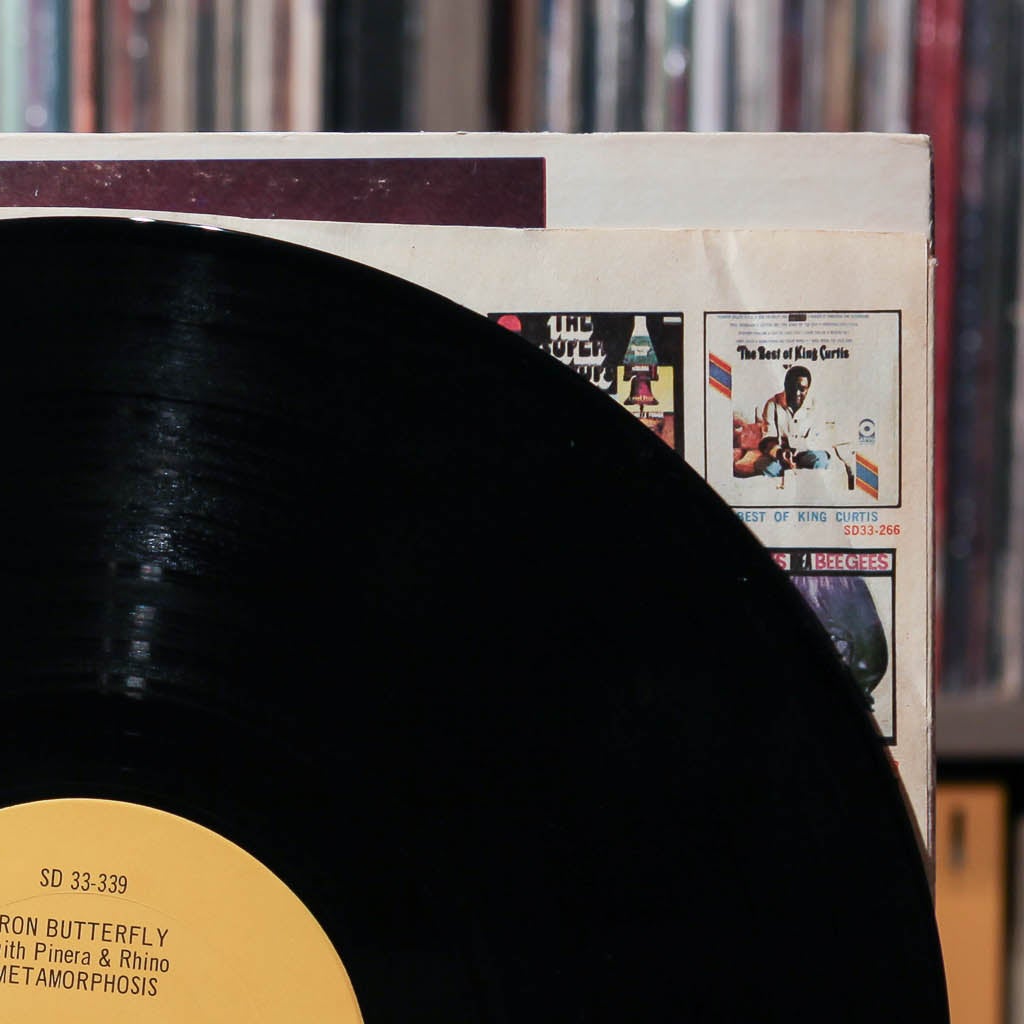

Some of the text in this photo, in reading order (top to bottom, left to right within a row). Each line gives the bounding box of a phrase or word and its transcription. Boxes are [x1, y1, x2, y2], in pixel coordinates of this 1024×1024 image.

[736, 344, 849, 361] The Best of King Curtis
[773, 511, 789, 522] OF
[798, 511, 827, 522] KING
[835, 511, 879, 522] CURTIS
[843, 525, 901, 536] SD33-266
[39, 867, 128, 894] SD 33-339
[46, 918, 169, 948] BUTTERFLY
[34, 941, 91, 966] Pinera
[98, 948, 111, 968] &
[119, 949, 170, 973] Rhino
